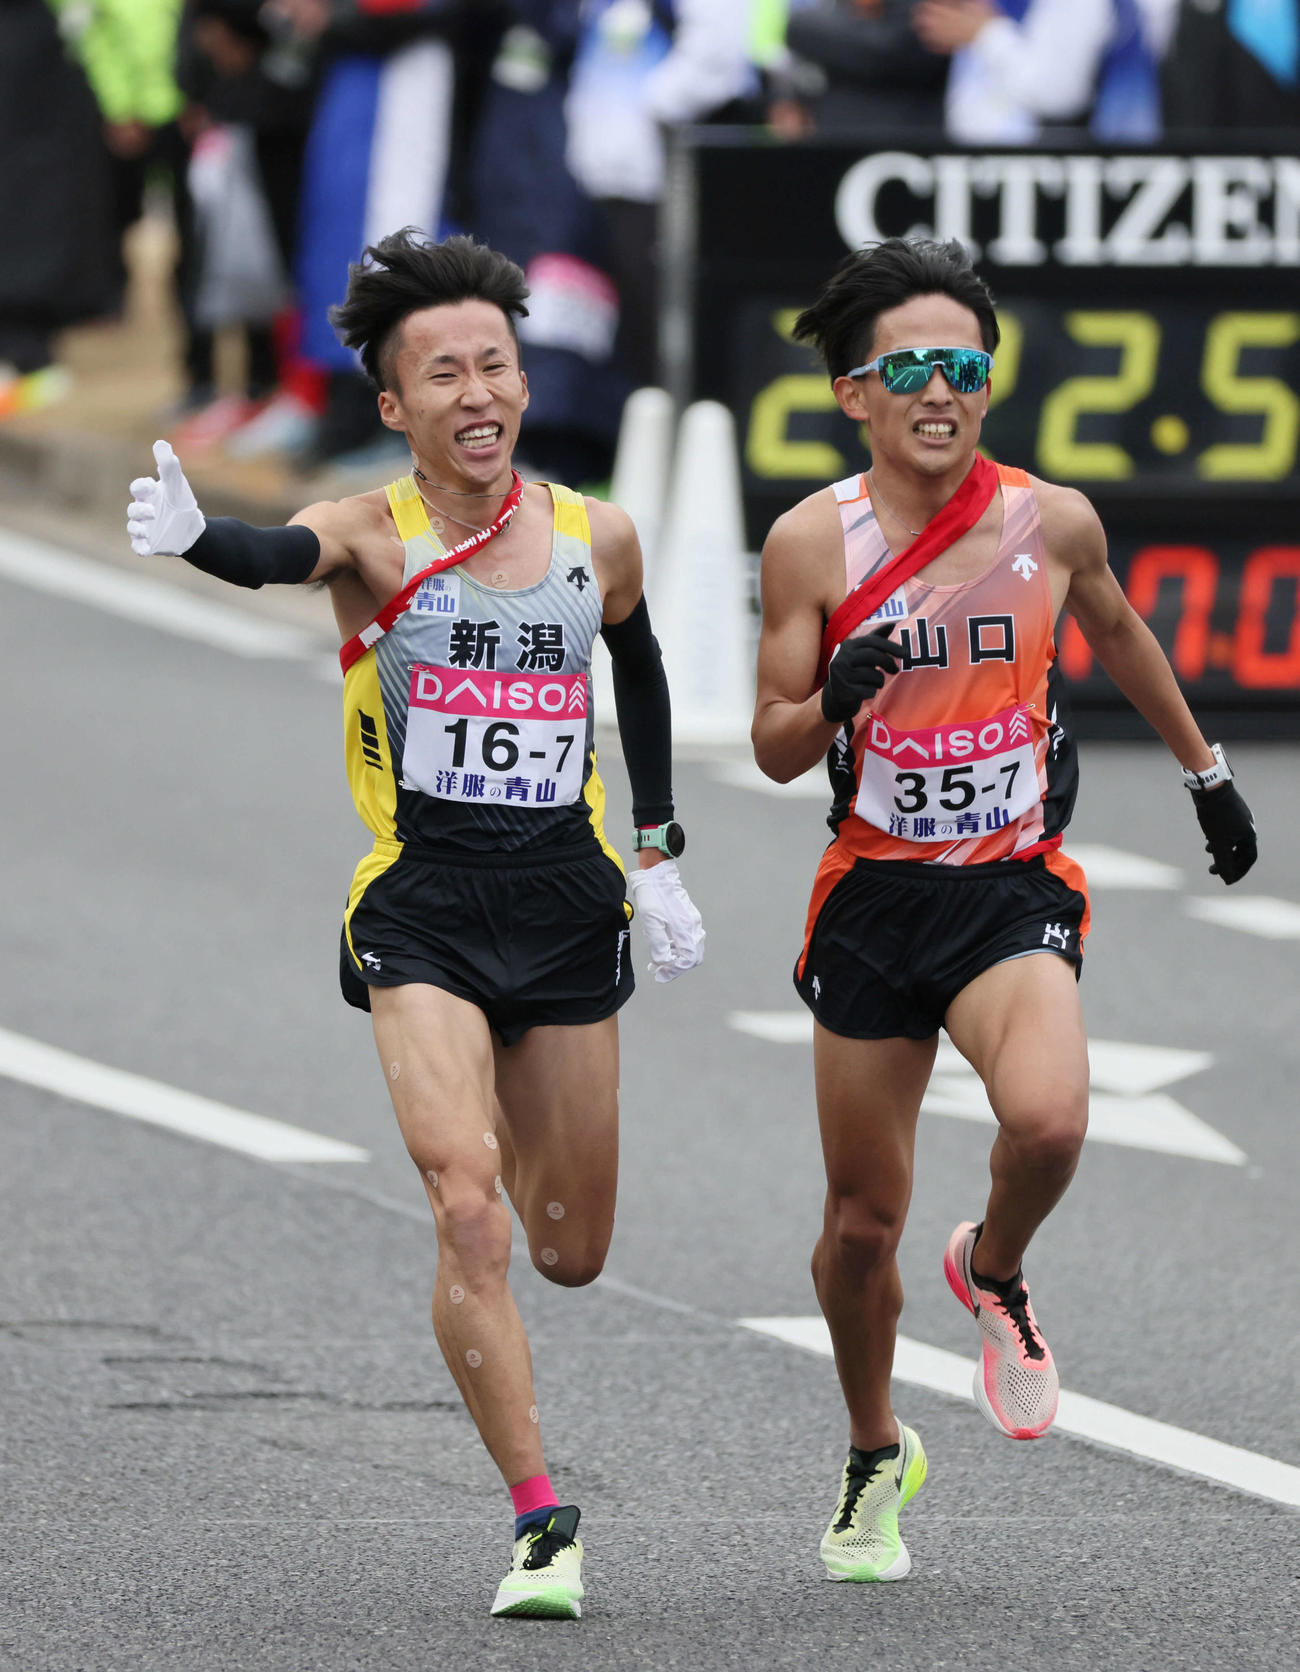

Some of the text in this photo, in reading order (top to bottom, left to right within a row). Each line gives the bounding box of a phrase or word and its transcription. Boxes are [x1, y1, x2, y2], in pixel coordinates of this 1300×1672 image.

[835, 152, 1300, 266] CITIZE
[416, 592, 455, 613] 青山
[448, 618, 567, 672] 新潟
[899, 613, 1016, 672] 山口
[416, 672, 566, 712] DAISO
[444, 718, 575, 773] 16-7
[870, 721, 1004, 760] DAISO
[435, 769, 556, 803] 洋服の青山
[894, 760, 1022, 814] 35-7
[888, 805, 1010, 839] 洋服の青山
